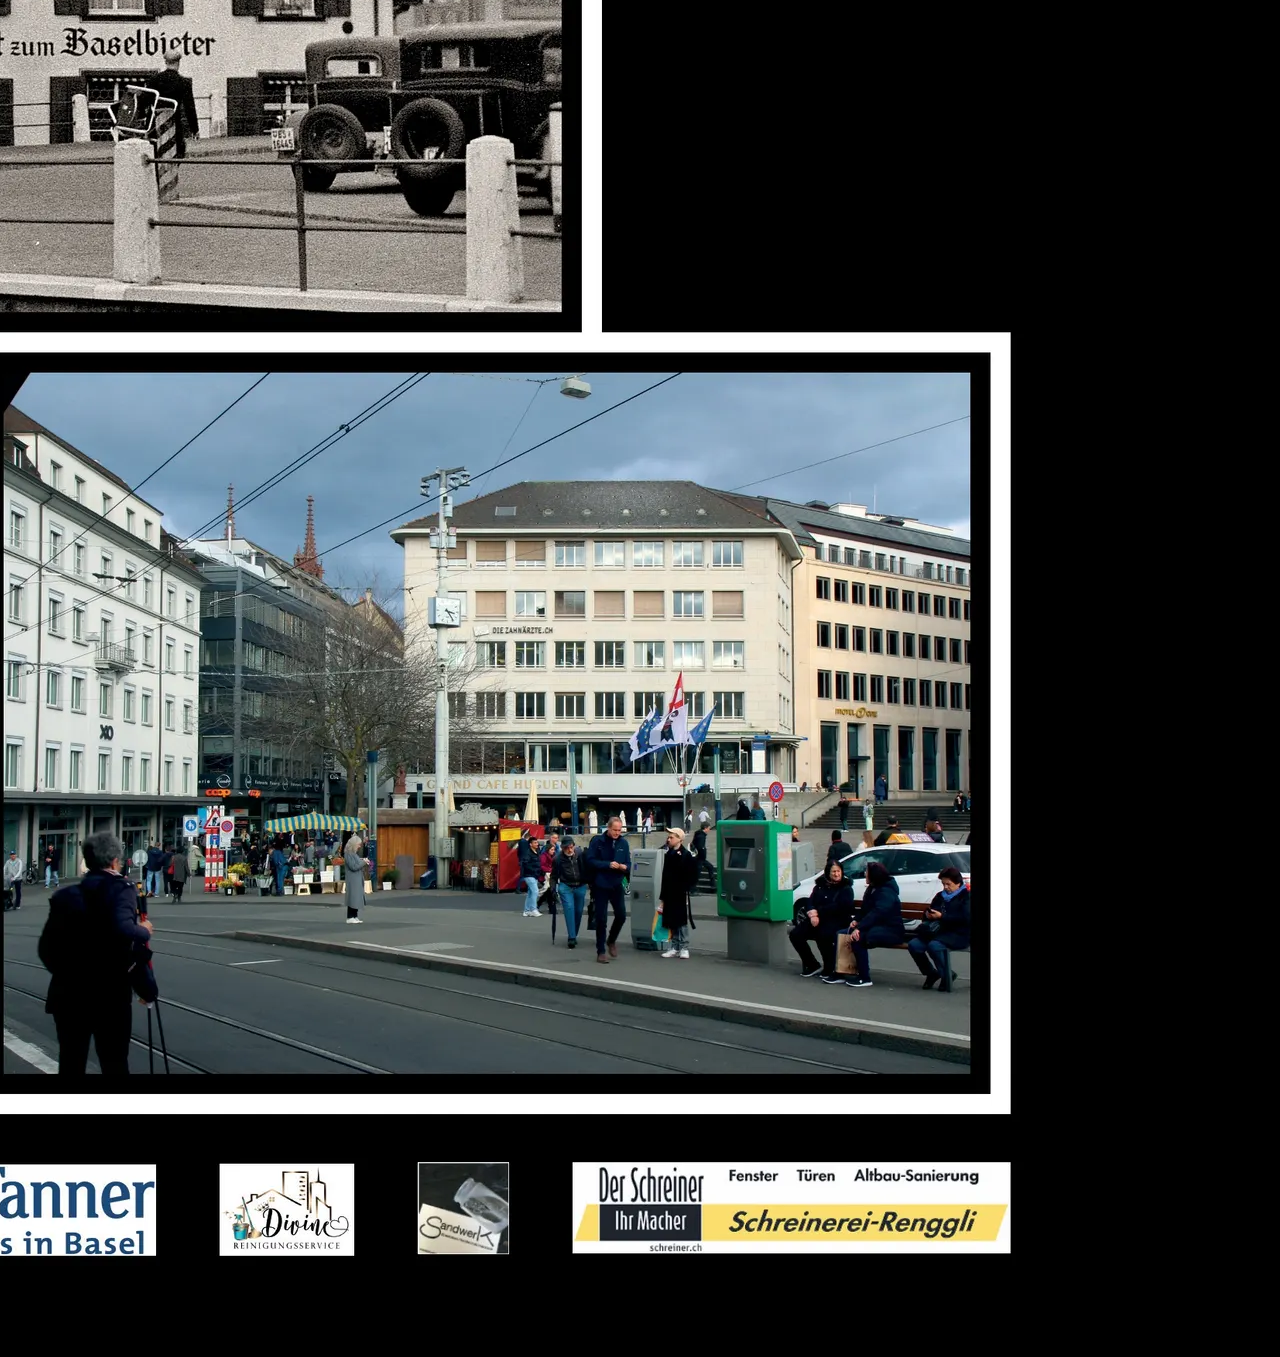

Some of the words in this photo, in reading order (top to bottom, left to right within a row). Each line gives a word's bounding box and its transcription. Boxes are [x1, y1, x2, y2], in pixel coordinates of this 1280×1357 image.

[10, 39, 56, 57] zum
[60, 27, 218, 58] Baselbieter
[492, 626, 504, 635] DIE
[99, 724, 114, 741] XO
[426, 779, 471, 790] GND
[477, 779, 508, 790] CAFE
[514, 779, 584, 790] HUGUENN
